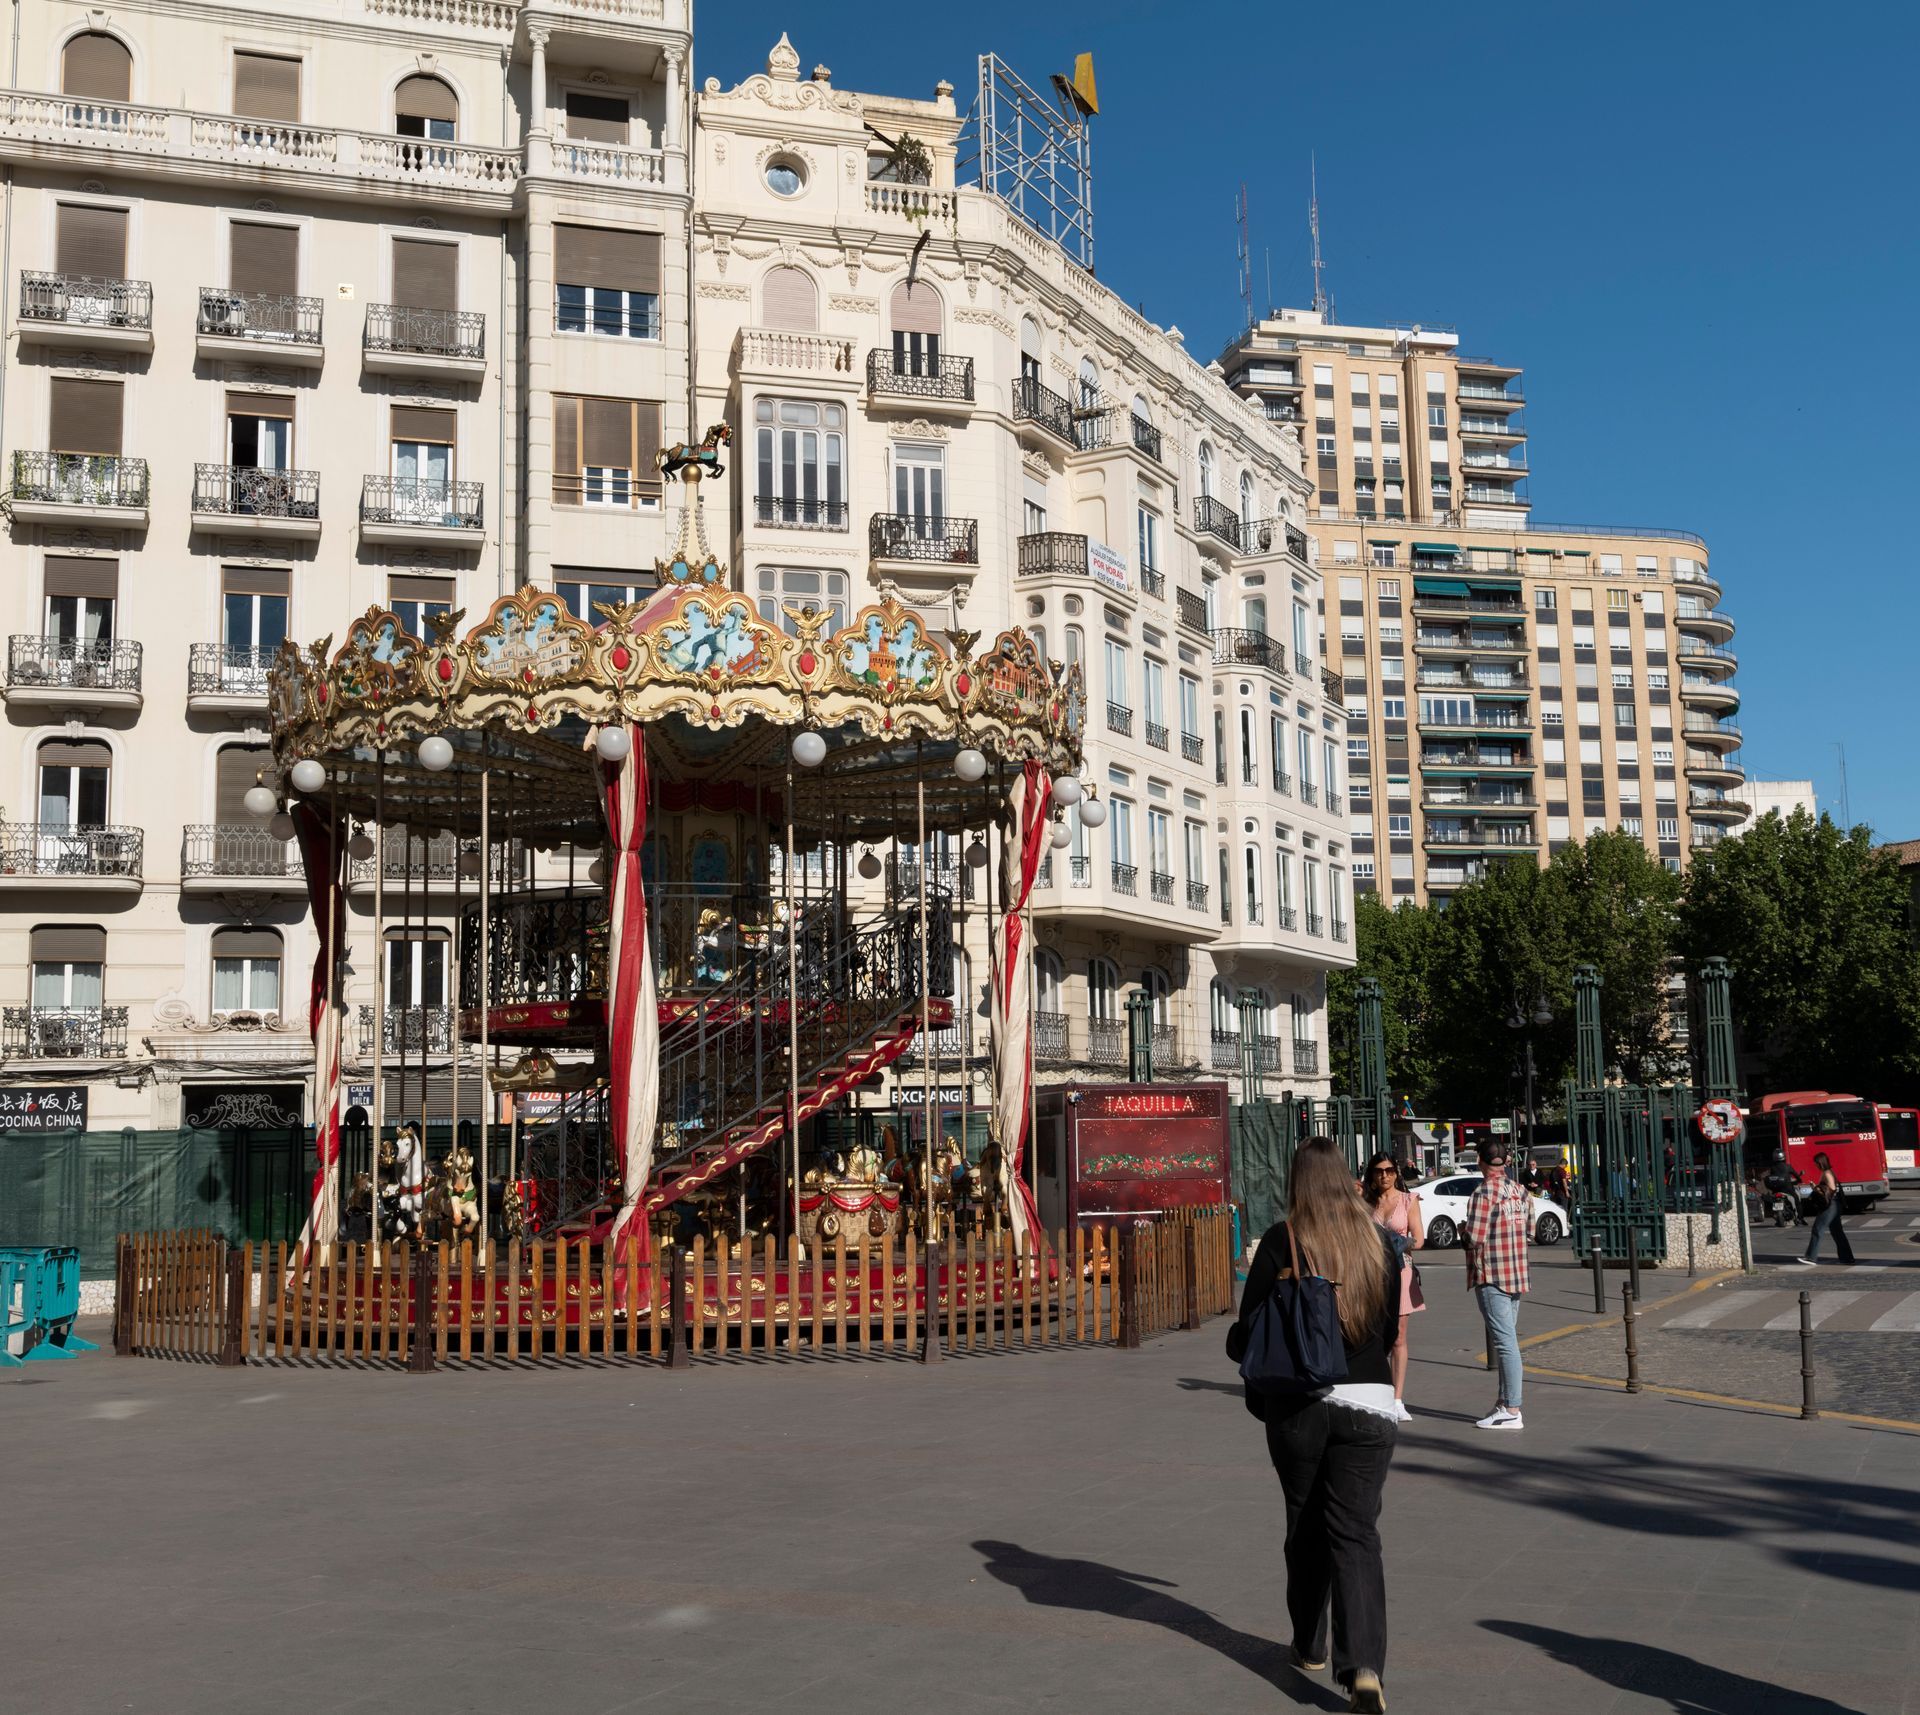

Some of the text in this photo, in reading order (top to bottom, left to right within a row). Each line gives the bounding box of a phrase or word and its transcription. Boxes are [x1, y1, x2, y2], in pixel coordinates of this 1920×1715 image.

[1094, 558, 1123, 580] POR HORAS
[1105, 1095, 1195, 1112] TAQUILLA
[0, 1114, 83, 1128] COCINA CHINA
[1824, 1120, 1836, 1129] 67
[1858, 1131, 1877, 1141] 9235
